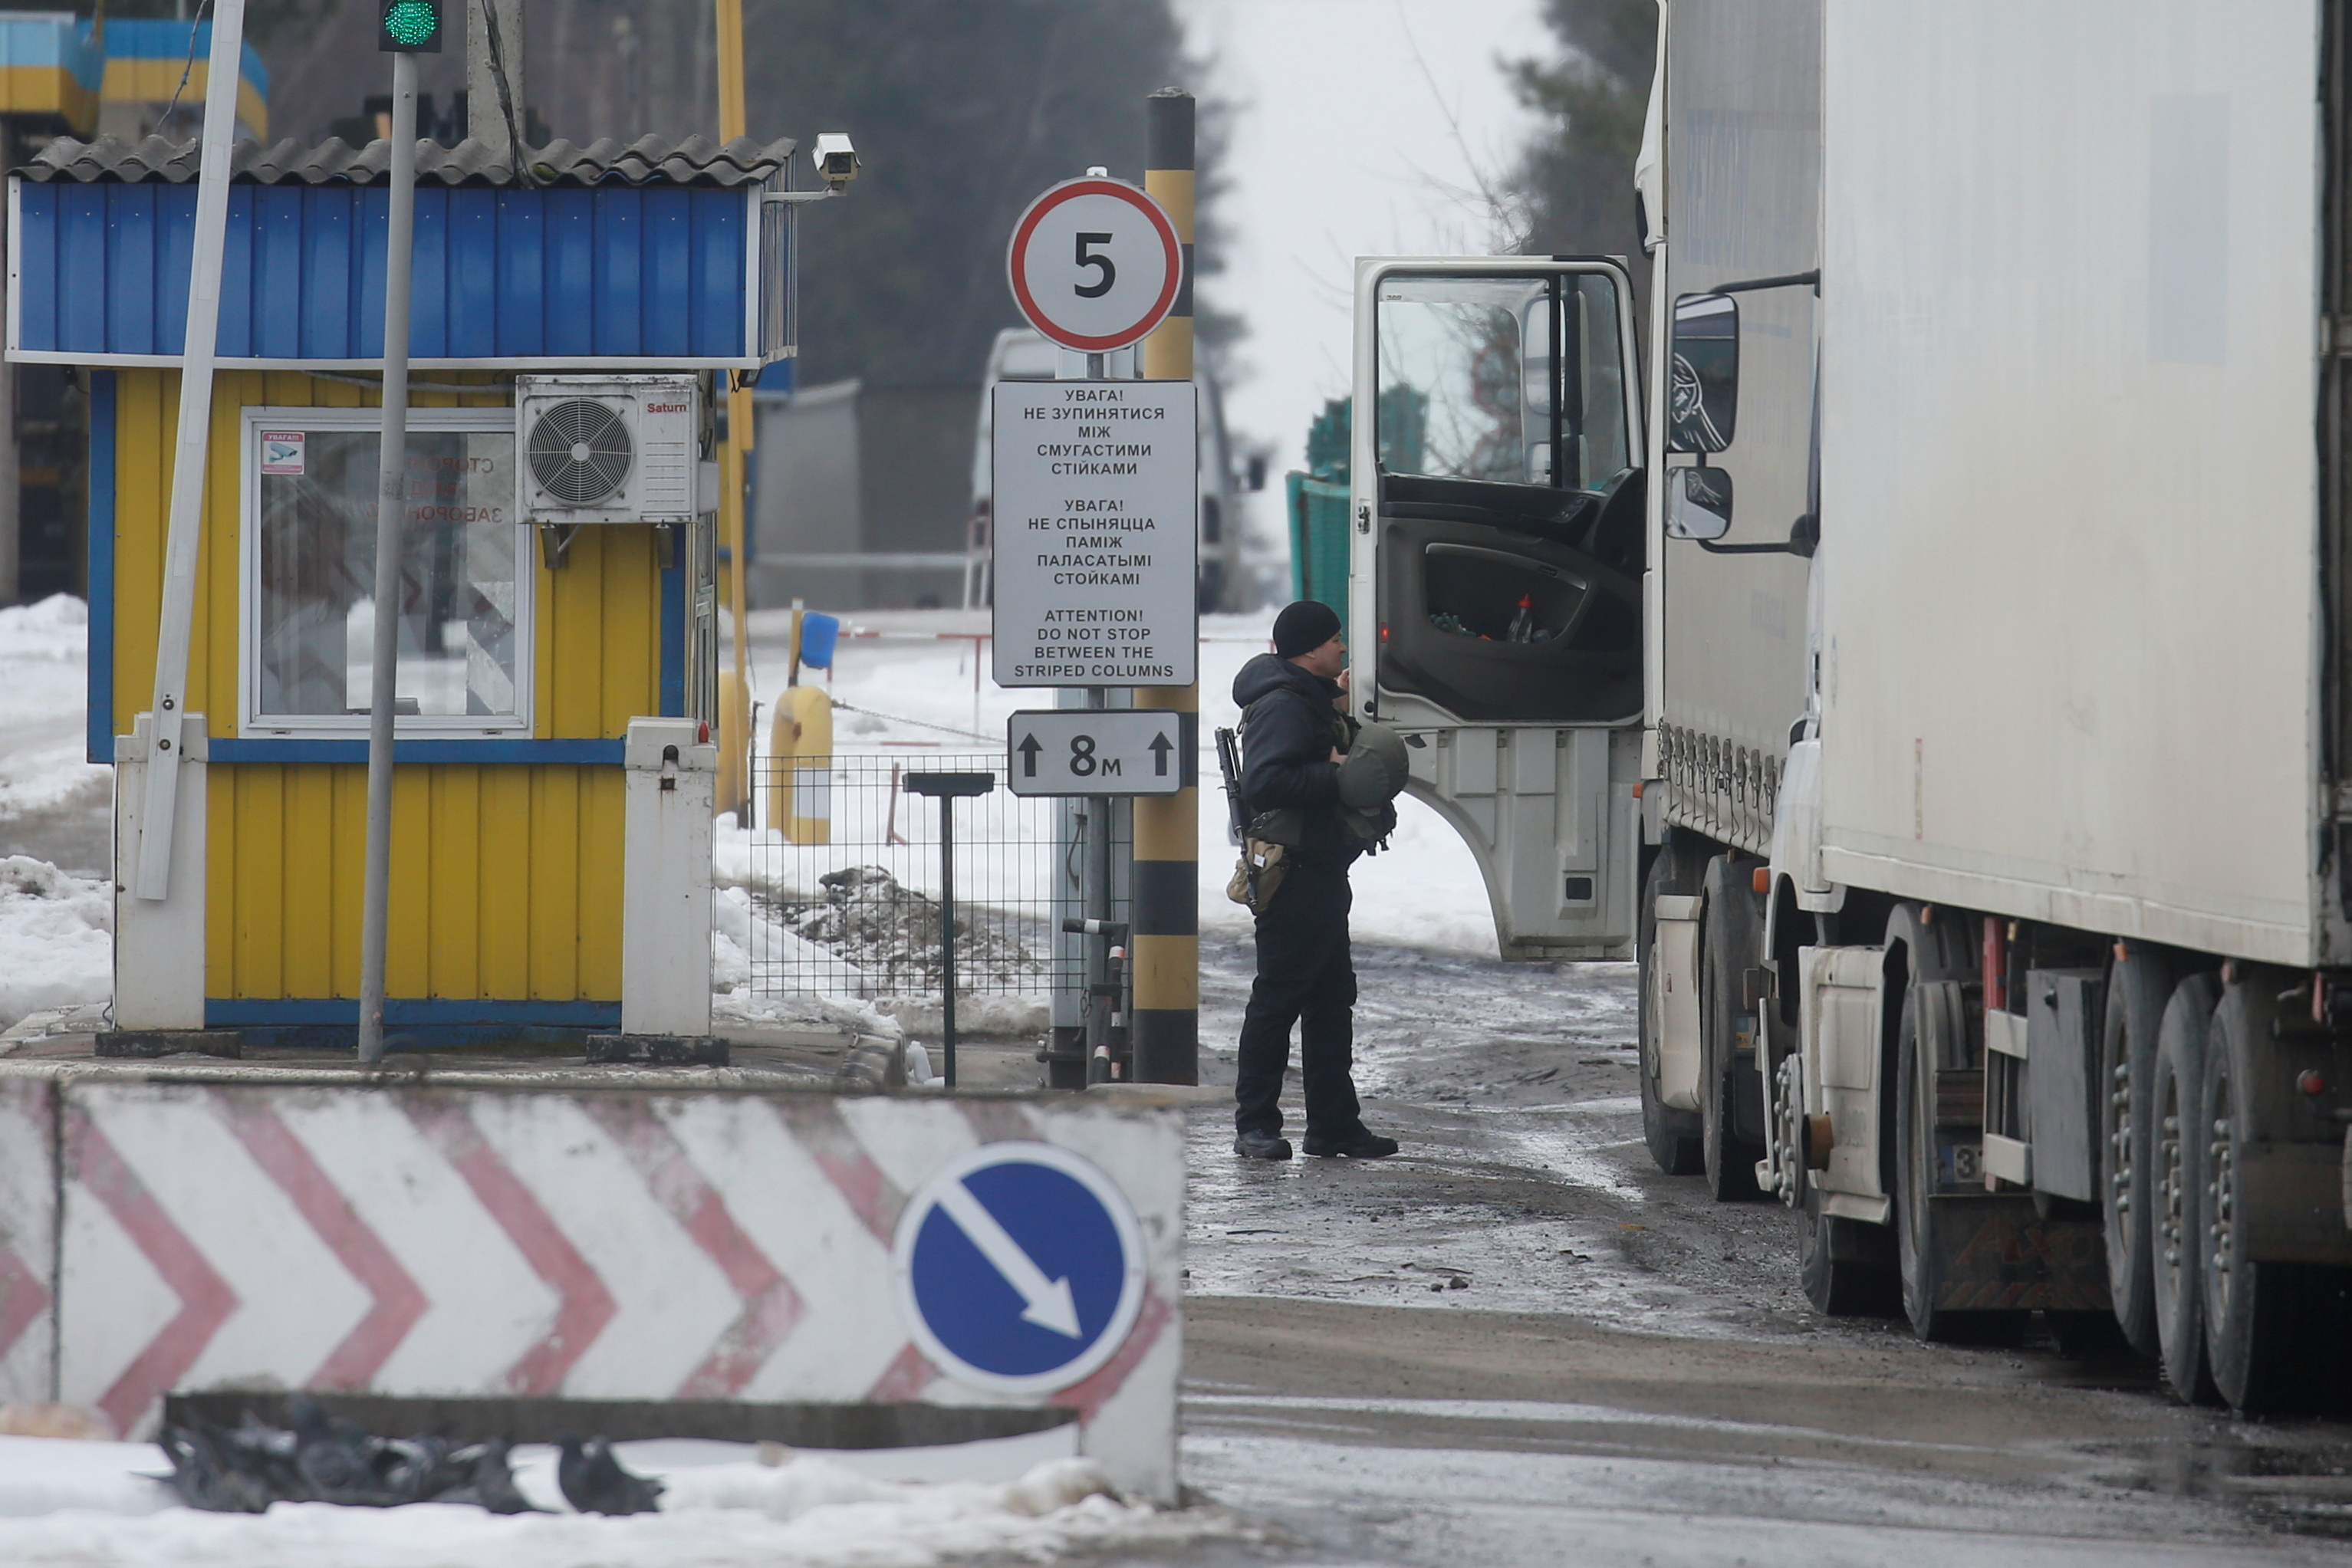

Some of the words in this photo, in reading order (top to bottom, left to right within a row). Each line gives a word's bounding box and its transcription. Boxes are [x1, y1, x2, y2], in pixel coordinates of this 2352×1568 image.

[1074, 232, 1116, 298] 5
[1065, 390, 1123, 402] УВАГА!
[646, 403, 687, 413] Saturn
[1024, 407, 1046, 420] НЕ
[1051, 407, 1165, 420] ЗУПИНЯТИСЯ
[1078, 426, 1111, 438] МІЖ
[1037, 444, 1152, 456] СМУГАСТИМИ
[1051, 460, 1137, 475] СТІЙКАМИ
[1064, 499, 1123, 511] УВАГА!
[1028, 518, 1050, 530] НЕ
[1056, 518, 1156, 532] СПЫНЯЦЦА
[1065, 536, 1123, 548] ПАМІЖ
[1037, 554, 1151, 567] ПАЛАСАТЫМІ
[1053, 570, 1140, 585] СТОЙКАМІ
[1044, 610, 1143, 622] ATTENTION!
[1037, 628, 1061, 640] DO
[1067, 628, 1101, 640] NOT
[1107, 628, 1151, 640] STOP
[1035, 646, 1116, 659] BETWEEN
[1121, 646, 1154, 659] THE
[1014, 665, 1085, 677] STRIPED
[1090, 665, 1174, 677] COLUMNS
